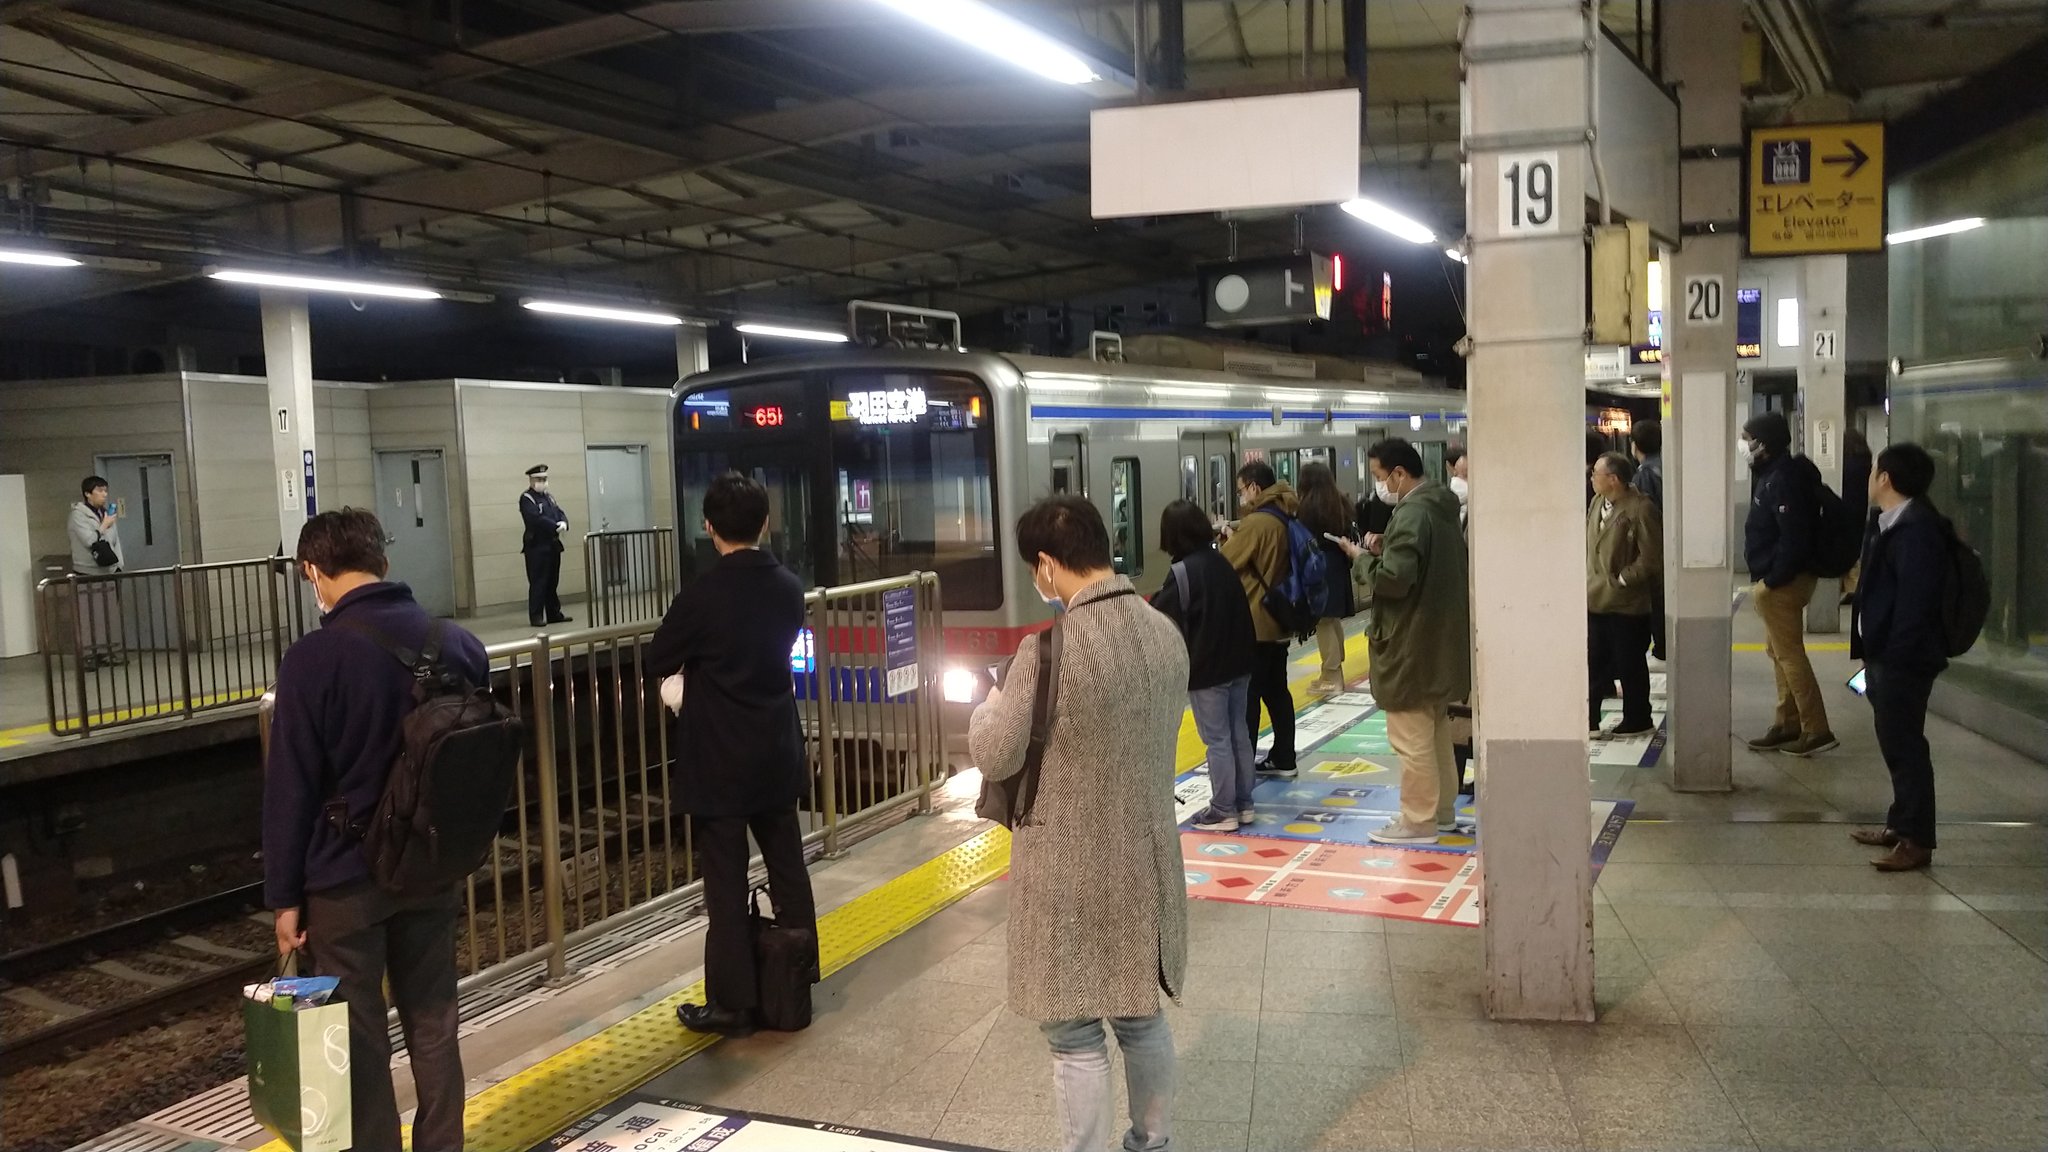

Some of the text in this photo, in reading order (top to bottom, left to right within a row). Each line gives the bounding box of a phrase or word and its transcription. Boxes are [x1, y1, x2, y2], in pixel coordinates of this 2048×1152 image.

[1503, 160, 1554, 227] 19
[1755, 190, 1876, 214] エレベーター
[1783, 215, 1848, 228] Elevator
[1687, 278, 1720, 320] 20
[1815, 332, 1835, 356] 21
[278, 409, 287, 430] 17
[671, 1101, 703, 1112] Local
[634, 1127, 674, 1152] ocal
[828, 1124, 861, 1136] Local
